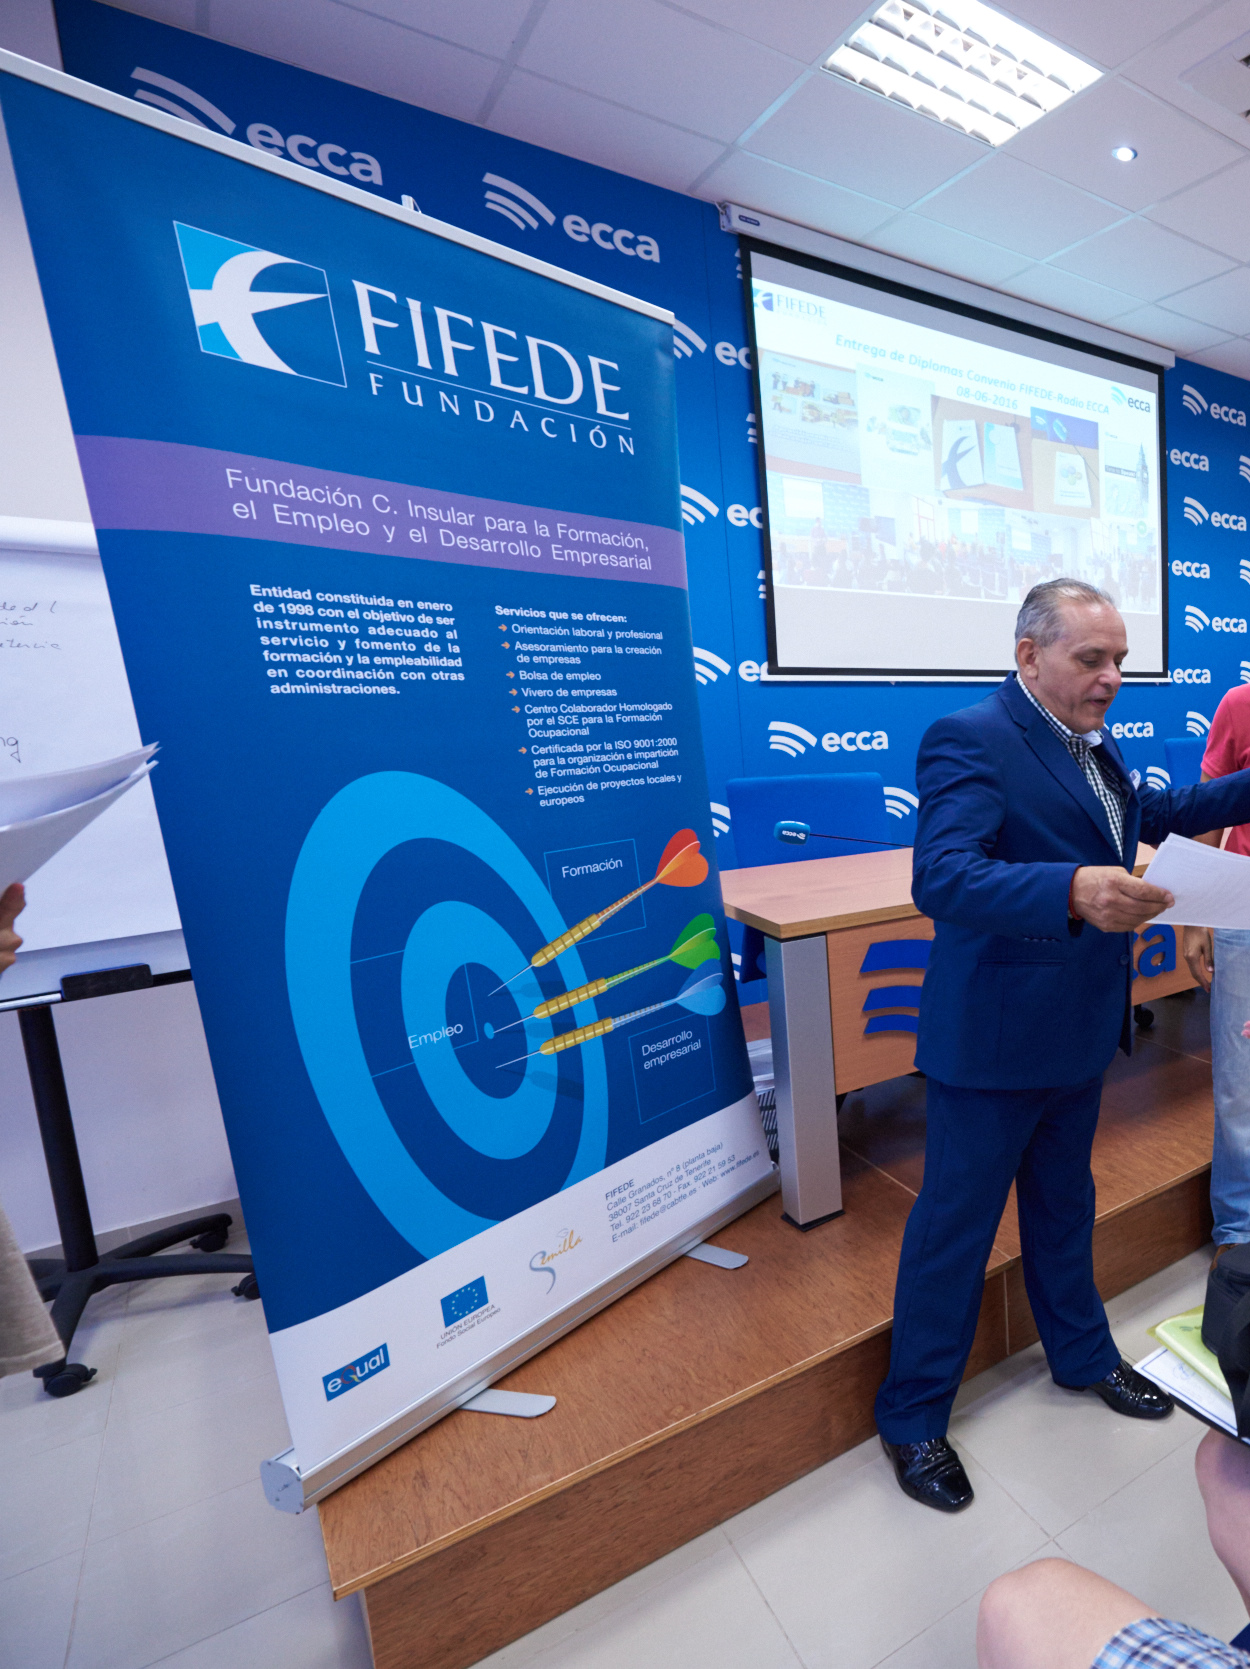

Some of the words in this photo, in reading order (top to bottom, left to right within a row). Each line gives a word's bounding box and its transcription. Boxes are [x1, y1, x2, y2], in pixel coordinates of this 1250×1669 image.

[246, 122, 383, 186] ecca
[563, 213, 661, 263] ecca
[777, 294, 826, 320] FIFEDE
[351, 279, 630, 421] FIFEDE
[835, 334, 887, 361] Entrega
[889, 348, 905, 363] de
[908, 348, 964, 379] Diplomas
[966, 368, 1017, 392] Convenio
[1019, 383, 1084, 410] FIFEDE-Radio
[1086, 402, 1110, 416] ECCA
[956, 385, 1019, 411] 08-06-2016
[1127, 396, 1151, 413] ecca
[369, 372, 635, 456] FUNDACIÓN
[1210, 402, 1247, 427] ecca
[1169, 448, 1210, 472] ecca
[225, 467, 362, 510] Fundación
[372, 494, 399, 516] C.
[407, 499, 476, 526] Insular
[484, 516, 527, 535] para
[533, 519, 550, 538] la
[556, 522, 649, 553] Formación,
[1211, 511, 1247, 532] ecca
[231, 498, 258, 521] el
[274, 506, 371, 539] Empleo
[382, 523, 396, 543] y
[408, 526, 428, 545] el
[439, 529, 542, 560] Desarrollo
[551, 544, 653, 571] Empresarial
[1172, 559, 1210, 579] ecca
[250, 584, 312, 601] Entidad
[316, 591, 394, 608] constituida
[397, 599, 414, 609] en
[417, 600, 453, 612] enero
[253, 601, 275, 614] de
[279, 602, 315, 617] 1998
[318, 607, 345, 619] con
[347, 608, 360, 620] el
[363, 609, 415, 624] objetivo
[417, 613, 434, 625] de
[436, 616, 455, 626] ser
[495, 605, 546, 618] Servicios
[549, 611, 569, 621] que
[571, 612, 584, 620] se
[586, 612, 628, 623] ofrecen:
[256, 617, 360, 635] instrumento
[367, 624, 439, 639] adecuado
[445, 628, 458, 640] al
[511, 623, 570, 636] Orientación
[572, 627, 605, 638] laboral
[607, 630, 613, 640] y
[615, 629, 663, 641] profesional
[1212, 616, 1248, 634] ecca
[260, 634, 330, 648] servicio
[337, 639, 346, 651] y
[355, 638, 417, 652] fomento
[424, 641, 441, 653] de
[448, 642, 461, 654] la
[514, 641, 589, 653] Asesoramiento
[591, 646, 613, 655] para
[614, 645, 624, 654] la
[625, 646, 663, 655] creación
[263, 650, 343, 665] formación
[345, 654, 355, 666] y
[357, 653, 371, 665] la
[373, 656, 463, 668] empleabilidad
[516, 653, 531, 663] de
[532, 654, 581, 665] empresas
[267, 668, 288, 678] en
[295, 667, 395, 680] coordinación
[400, 671, 426, 681] con
[431, 670, 465, 682] otras
[519, 670, 549, 681] Bolsa
[550, 670, 564, 680] de
[565, 670, 602, 682] empleo
[1173, 668, 1211, 685] ecca
[270, 682, 401, 695] administraciones.
[521, 687, 554, 697] Vivero
[555, 687, 569, 697] de
[571, 688, 618, 699] empresas
[524, 704, 558, 714] Centro
[559, 703, 618, 714] Colaborador
[618, 702, 673, 713] Homologado
[526, 717, 544, 728] por
[546, 716, 556, 726] el
[557, 715, 579, 725] SCE
[581, 715, 603, 726] para
[604, 714, 614, 724] la
[615, 712, 663, 723] Formación
[1112, 721, 1154, 739] ecca
[528, 726, 590, 739] Ocupacional
[822, 730, 889, 752] ecca
[531, 743, 584, 756] Certificada
[586, 743, 602, 753] por
[603, 741, 613, 751] la
[614, 740, 632, 750] ISO
[633, 737, 678, 749] 9001:2000
[533, 757, 556, 769] para
[557, 755, 566, 765] la
[567, 752, 625, 765] organización
[633, 748, 679, 760] impartición
[535, 769, 549, 779] de
[550, 765, 601, 778] Formación
[602, 760, 659, 773] Ocupacional
[537, 783, 584, 796] Ejecución
[586, 781, 599, 791] de
[600, 777, 645, 791] proyectos
[646, 774, 676, 784] locales
[539, 794, 585, 807] europeos
[561, 857, 624, 879] Formación
[408, 1022, 464, 1051] Empleo
[641, 1028, 694, 1057] Desarrollo
[643, 1039, 702, 1071] empresarial
[606, 1194, 627, 1211] Calle
[628, 1174, 666, 1199] Granados,
[682, 1153, 706, 1171] (planta
[707, 1142, 724, 1156] baja)
[605, 1179, 635, 1201] FIFEDE
[608, 1203, 632, 1223] 38007
[634, 1191, 656, 1208] Santa
[656, 1180, 673, 1195] Cruz
[675, 1174, 684, 1185] de
[685, 1159, 712, 1178] Tenerife
[611, 1223, 640, 1243] E-mail:
[720, 1150, 760, 1178] www.fifede.es
[610, 1219, 623, 1233] Tel.
[626, 1210, 640, 1224] 922
[642, 1204, 651, 1215] 23
[664, 1191, 672, 1202] 70
[678, 1181, 692, 1194] Fax.
[693, 1170, 707, 1184] 922
[529, 1229, 583, 1295] Semilla
[436, 1334, 457, 1350] Fondo
[457, 1324, 476, 1340] Social
[476, 1307, 502, 1331] Europeo
[440, 1322, 463, 1341] UNIÓN
[463, 1304, 496, 1329] EUROPEA
[327, 1348, 385, 1393] eQual
